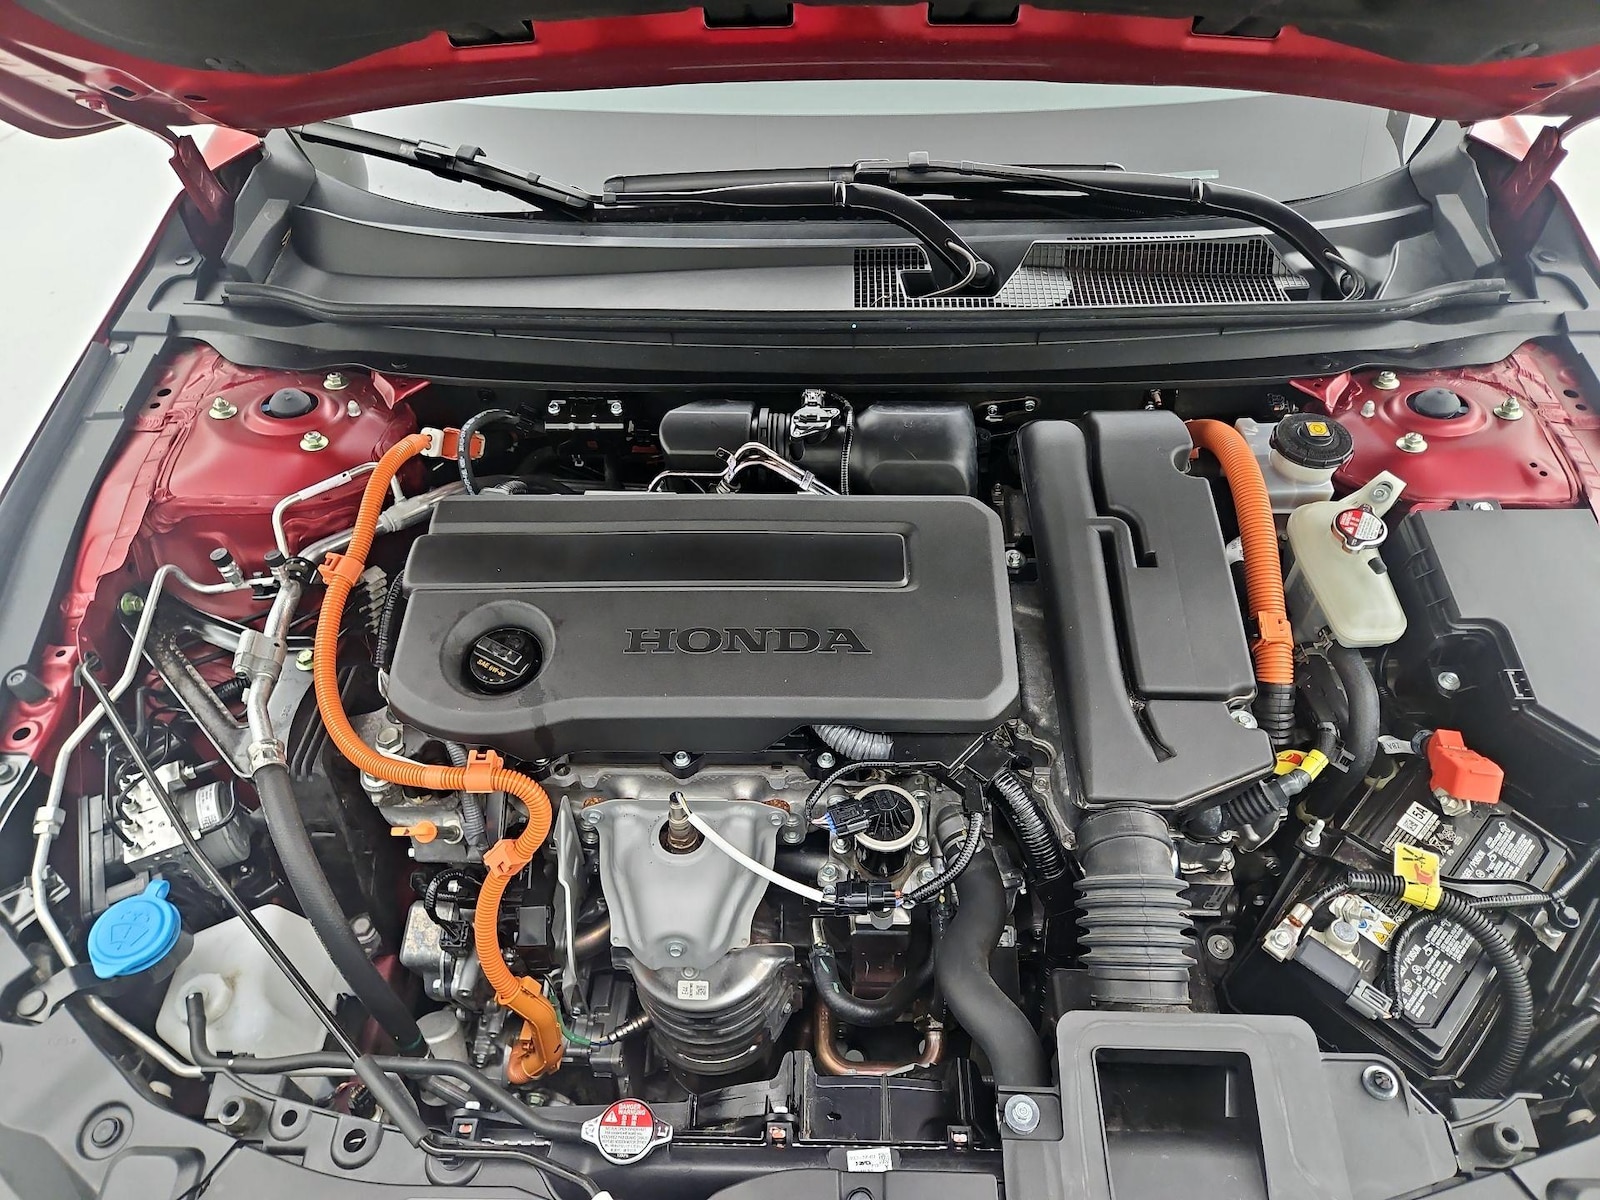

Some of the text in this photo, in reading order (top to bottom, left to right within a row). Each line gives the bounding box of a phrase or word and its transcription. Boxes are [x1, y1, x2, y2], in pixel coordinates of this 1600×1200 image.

[623, 627, 872, 654] HONDA
[476, 658, 490, 669] SAE
[1412, 806, 1428, 820] 5A
